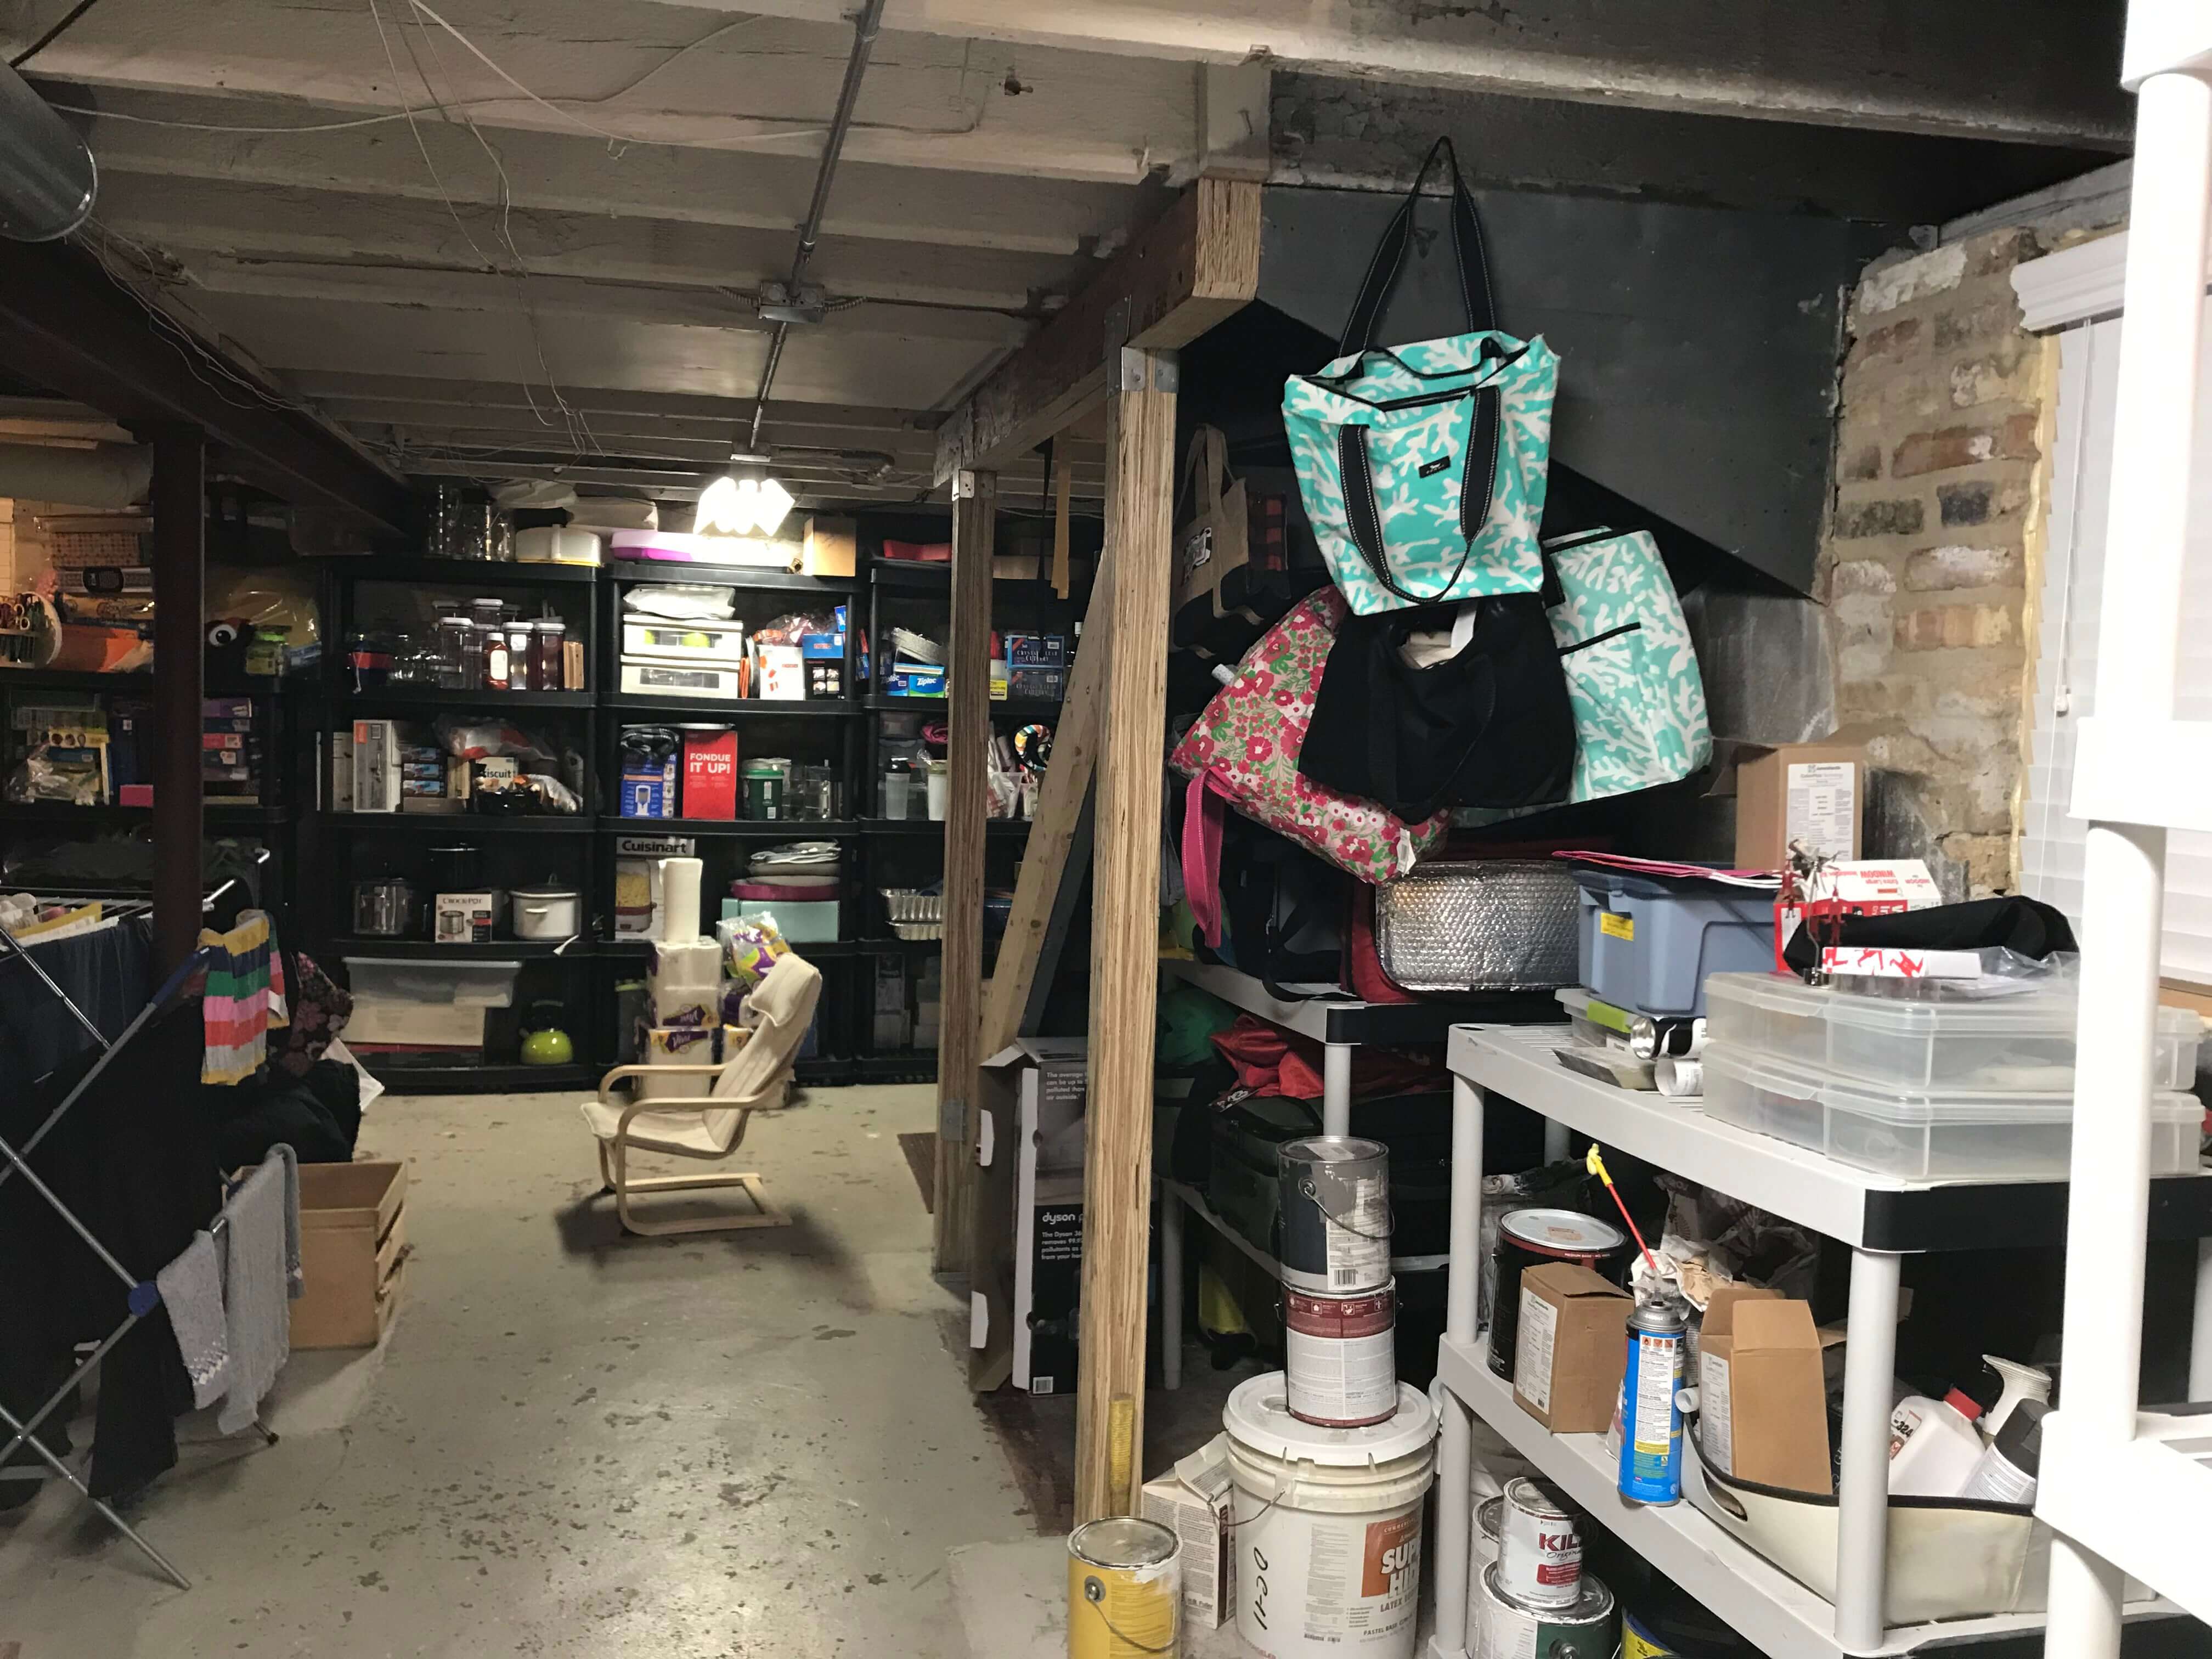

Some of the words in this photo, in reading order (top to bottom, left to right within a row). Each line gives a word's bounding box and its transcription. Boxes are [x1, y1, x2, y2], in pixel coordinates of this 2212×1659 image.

[917, 677, 937, 686] Ziploc
[690, 753, 731, 762] FONDUE
[690, 762, 703, 773] IT
[708, 762, 730, 774] UP!
[622, 839, 686, 854] Cuisinart
[1042, 1211, 1075, 1225] dyson
[1538, 1532, 1581, 1551] KIL
[1380, 1597, 1403, 1612] LATEX
[1363, 1627, 1384, 1635] PASTEL
